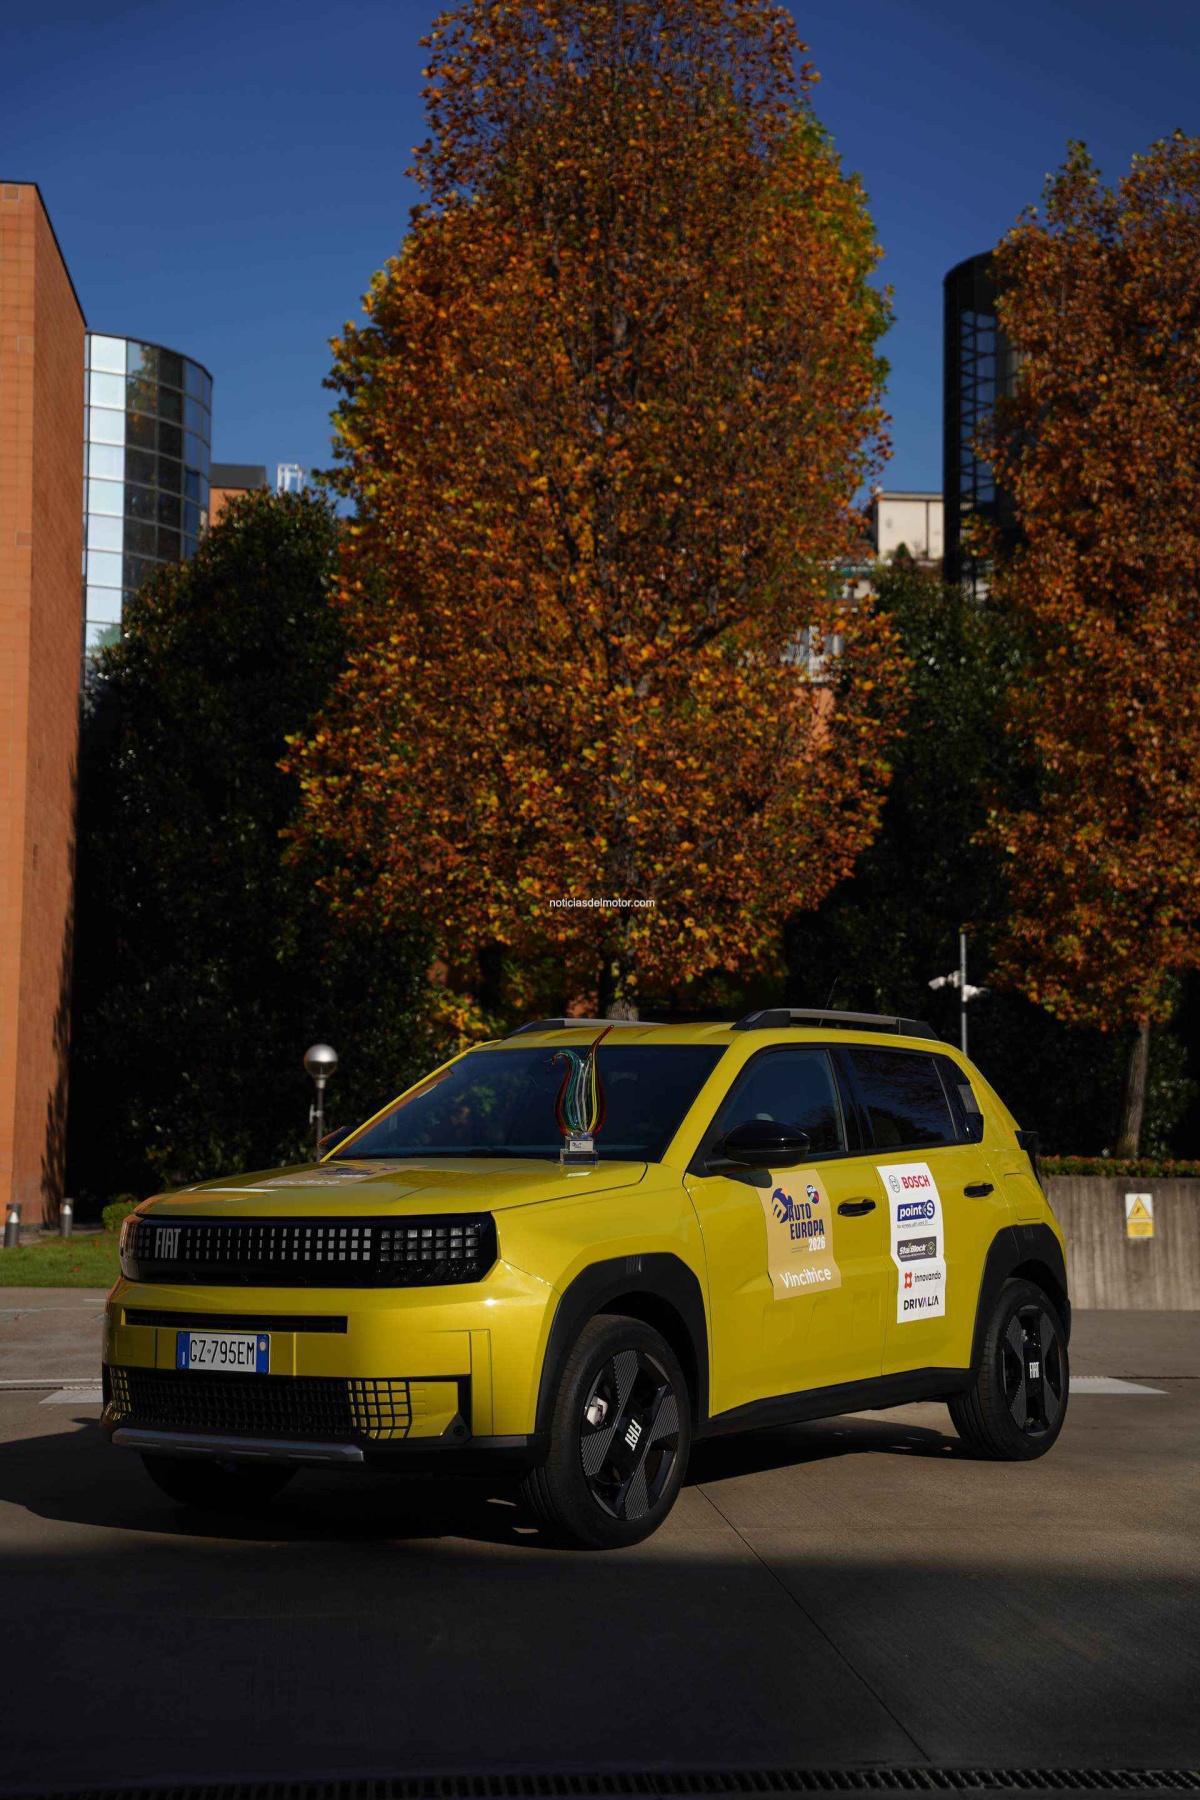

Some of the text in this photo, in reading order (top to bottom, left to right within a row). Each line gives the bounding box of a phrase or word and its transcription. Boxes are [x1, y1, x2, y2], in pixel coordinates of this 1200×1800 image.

[901, 1174, 931, 1189] BOSCH
[787, 1203, 812, 1222] AUTO
[900, 1202, 935, 1219] point S
[790, 1219, 825, 1240] EUROPA
[154, 1228, 181, 1259] FIAT
[780, 1267, 832, 1288] Vincitrice
[914, 1270, 941, 1283] innovando
[624, 1418, 642, 1451] FIAT
